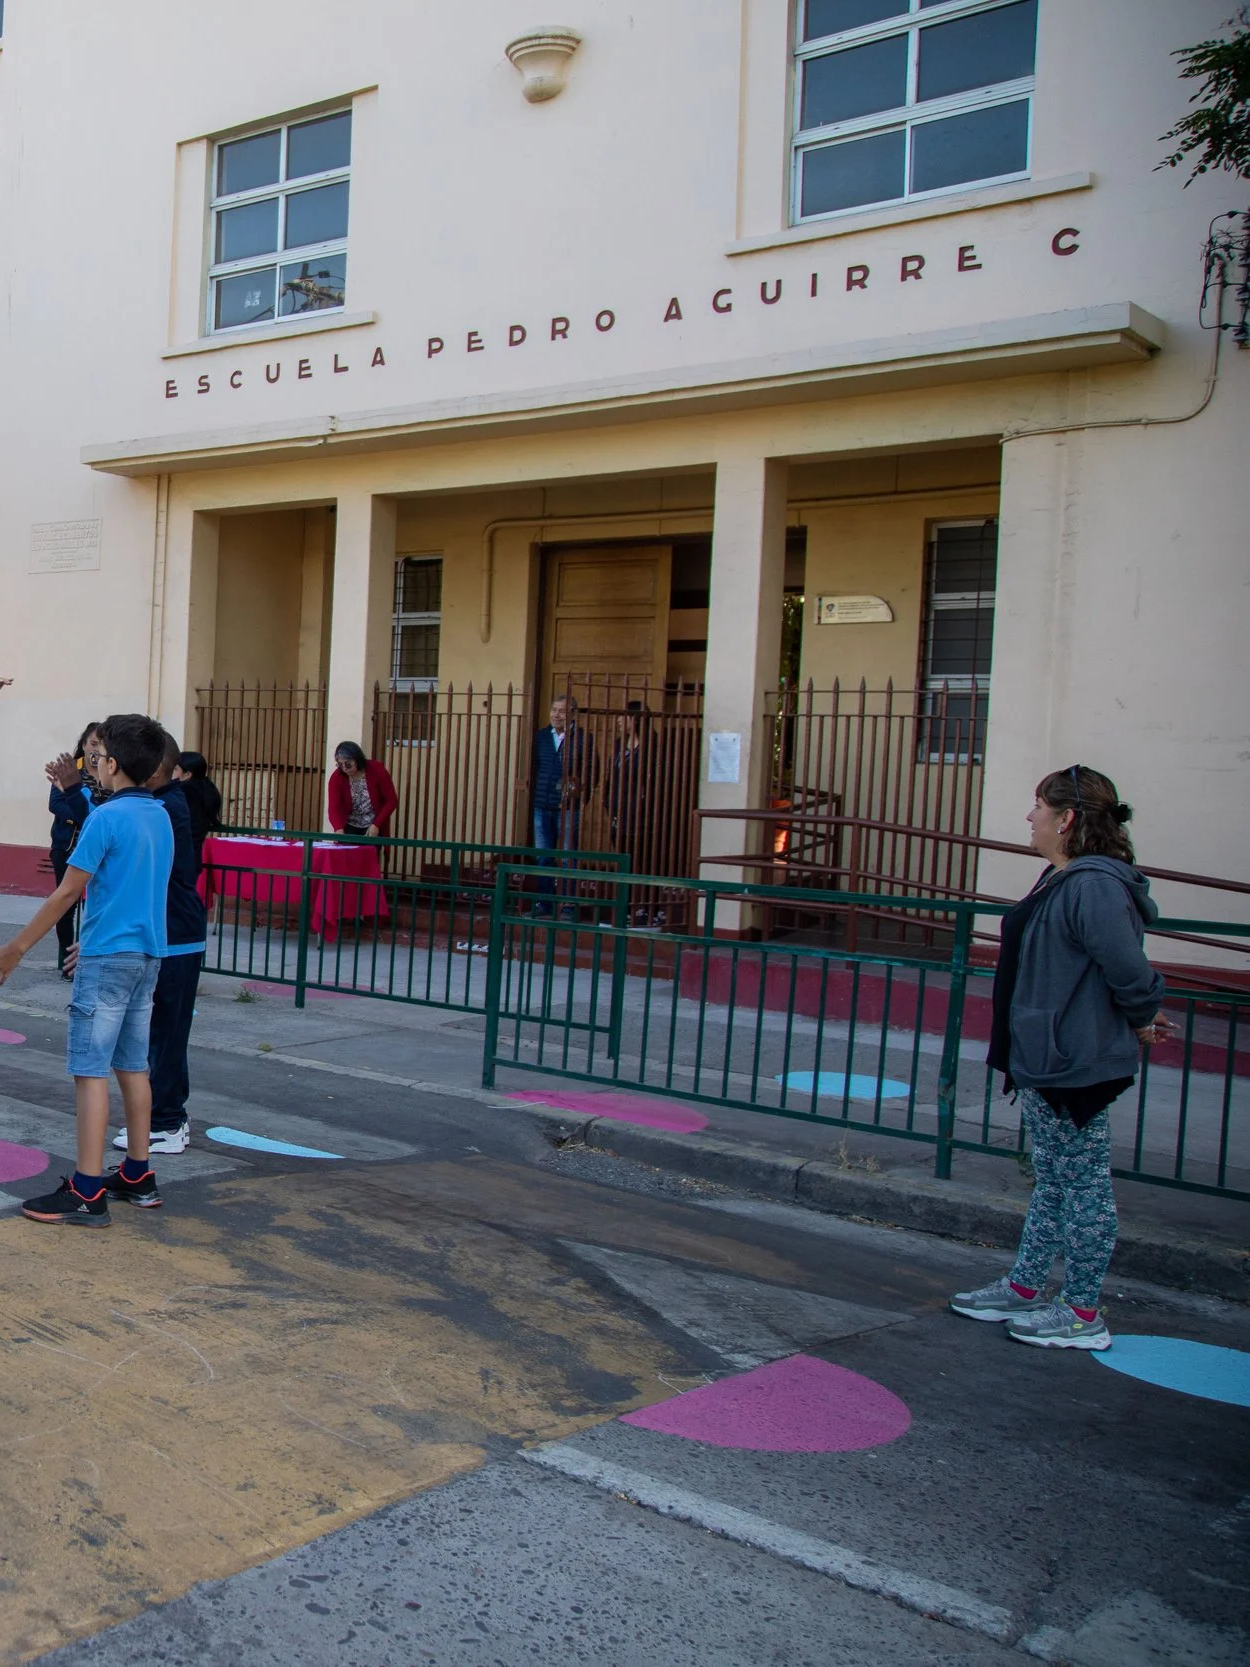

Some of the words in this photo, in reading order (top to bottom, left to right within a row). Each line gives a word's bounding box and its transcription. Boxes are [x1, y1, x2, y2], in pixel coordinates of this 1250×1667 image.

[166, 347, 385, 398] ESCUELA
[427, 309, 616, 358] PEDRO
[663, 244, 983, 323] AGUIRRE
[1051, 227, 1081, 257] C
